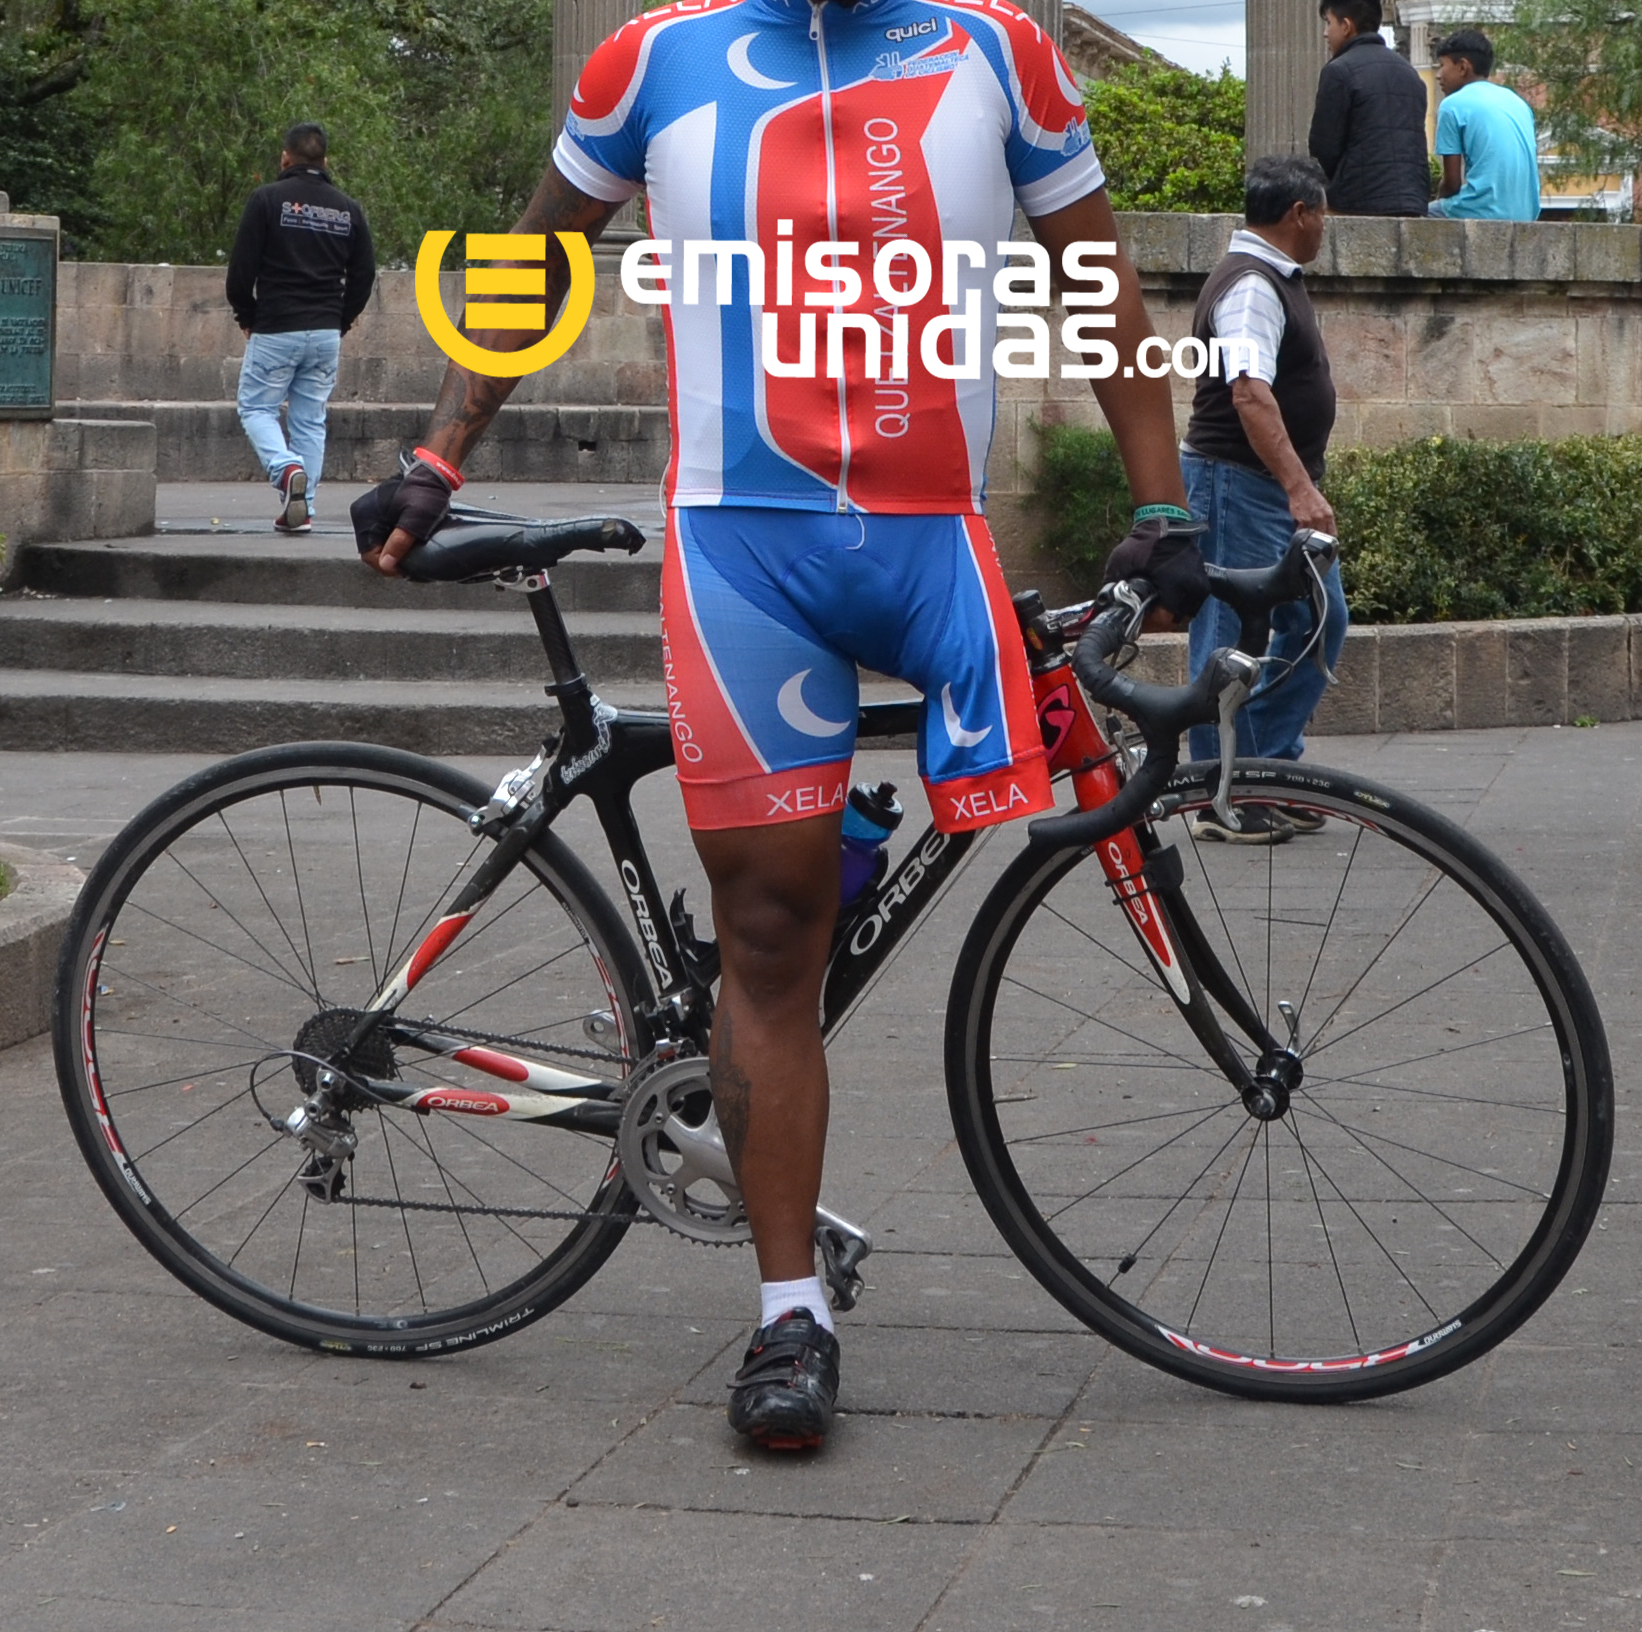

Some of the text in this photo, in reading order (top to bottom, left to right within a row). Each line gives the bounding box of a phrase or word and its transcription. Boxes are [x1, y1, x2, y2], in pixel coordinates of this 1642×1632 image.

[863, 118, 911, 439] QUEANANGO
[766, 782, 845, 817] XELA
[950, 783, 1029, 821] XELA
[850, 829, 951, 956] ORBE
[1108, 842, 1149, 925] ORBEA
[621, 859, 673, 990] ORBEA
[427, 1096, 500, 1113] ORBEA
[446, 1307, 535, 1346] TRIMLINE
